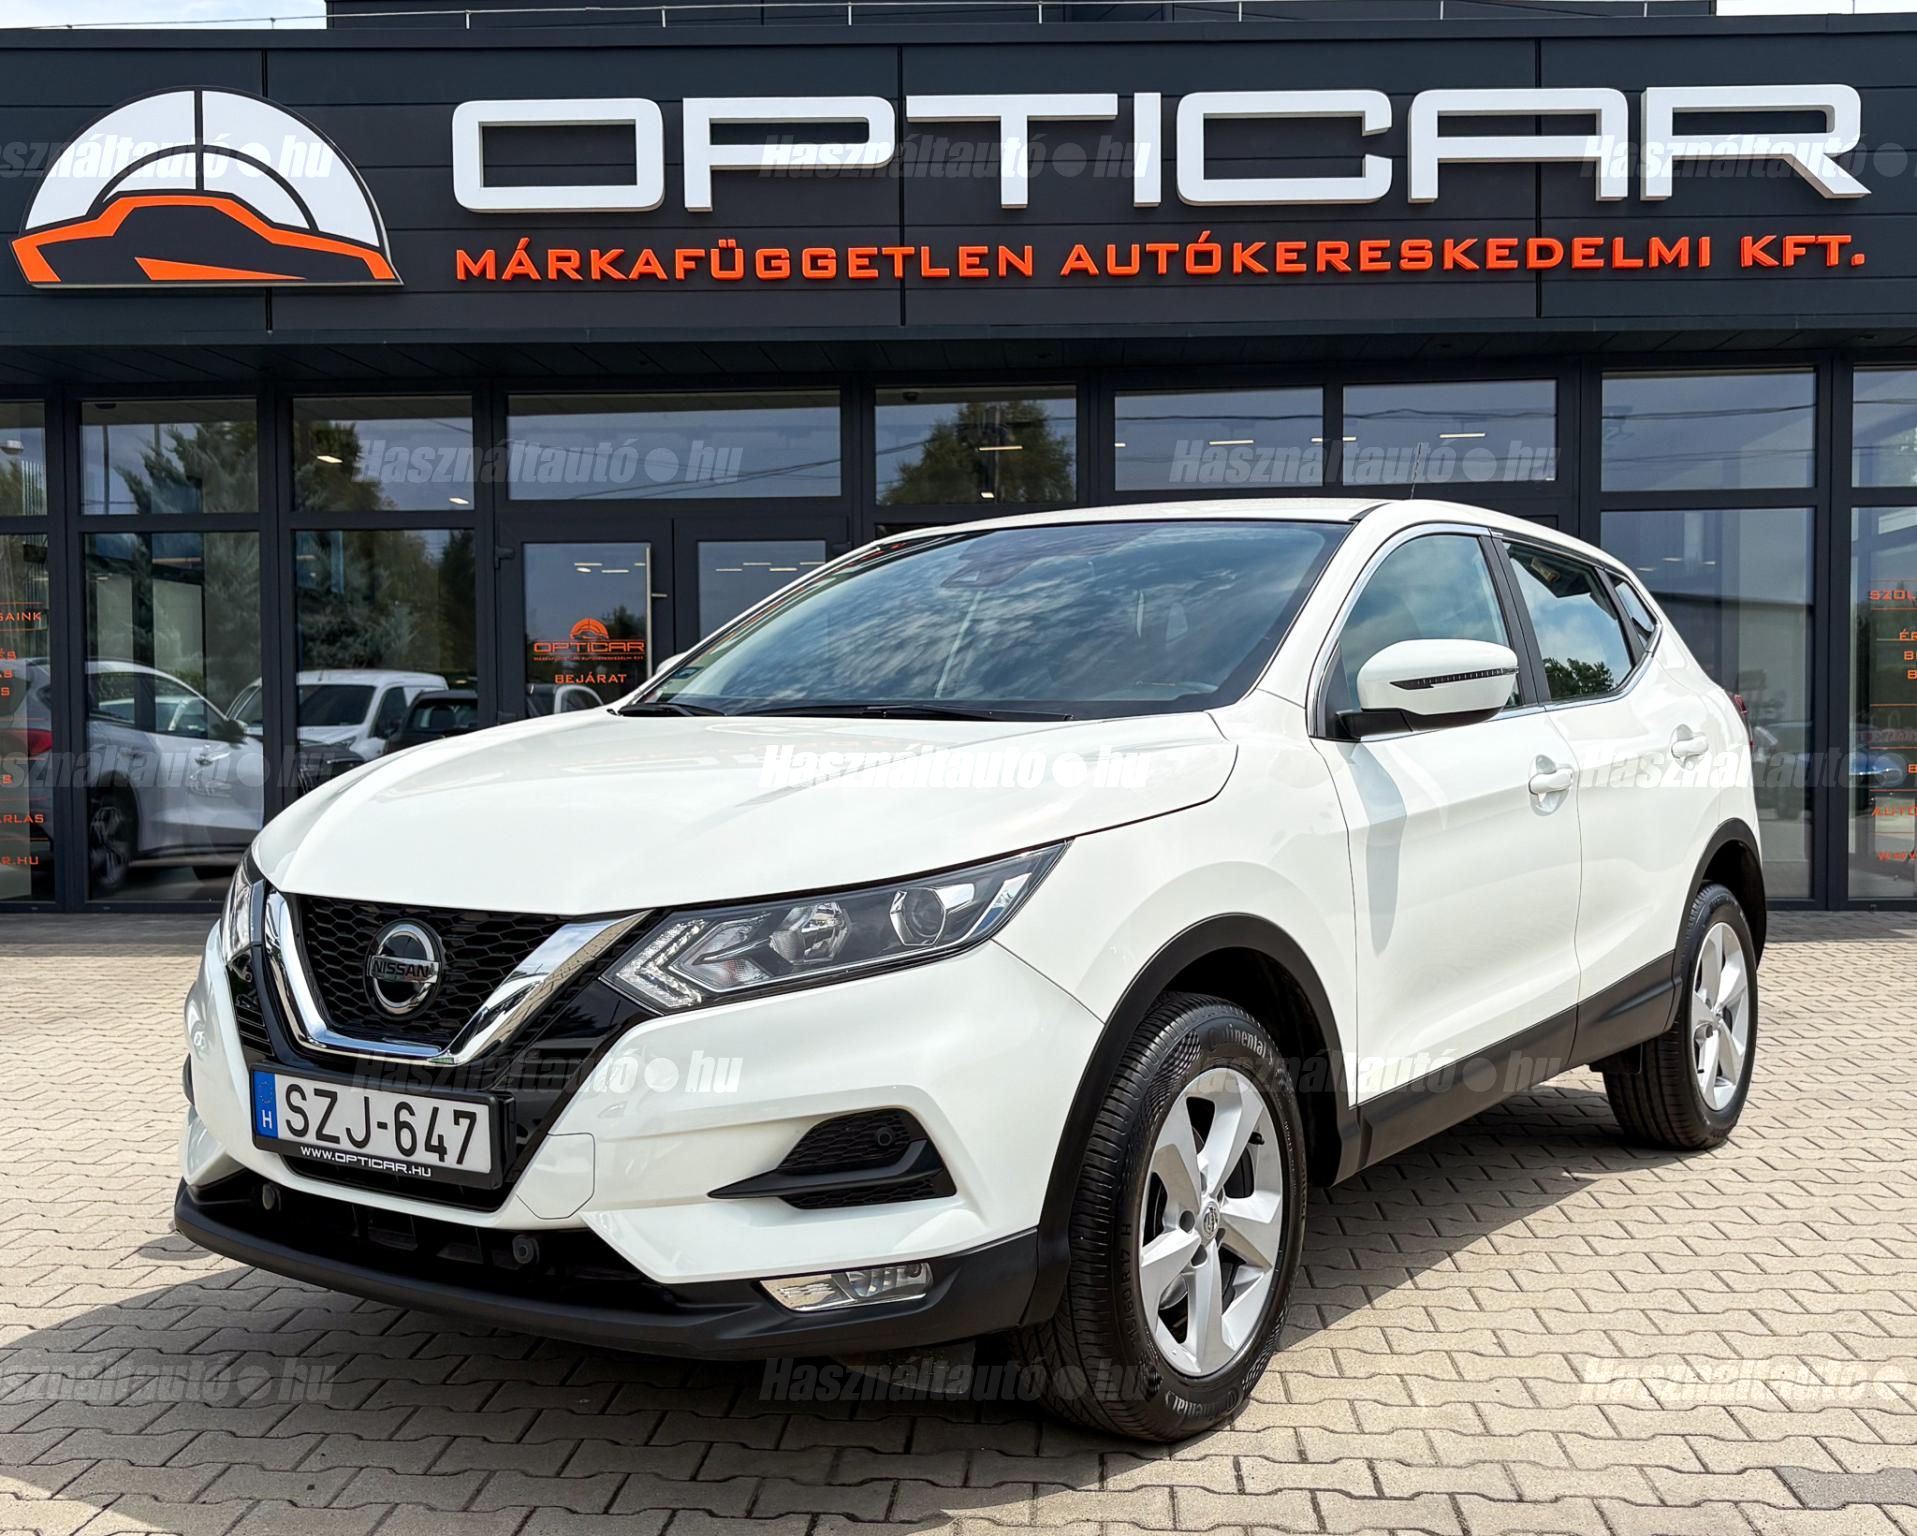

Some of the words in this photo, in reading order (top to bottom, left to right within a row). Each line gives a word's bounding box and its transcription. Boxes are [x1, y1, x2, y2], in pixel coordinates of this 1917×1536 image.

[452, 84, 1871, 213] OPTICAR
[455, 237, 1034, 281] MÁRKAFÜGGETLEN
[1060, 230, 1711, 277] AUTÓKERESKEDELMI
[1740, 234, 1866, 269] KFT.
[533, 642, 645, 653] OPTICAR
[554, 672, 627, 684] BEJÁRAT
[372, 960, 429, 978] NISSAN
[262, 1109, 272, 1130] H
[285, 1083, 478, 1166] SZJ-647
[300, 1146, 432, 1177] WWW.OPTICAR.HU
